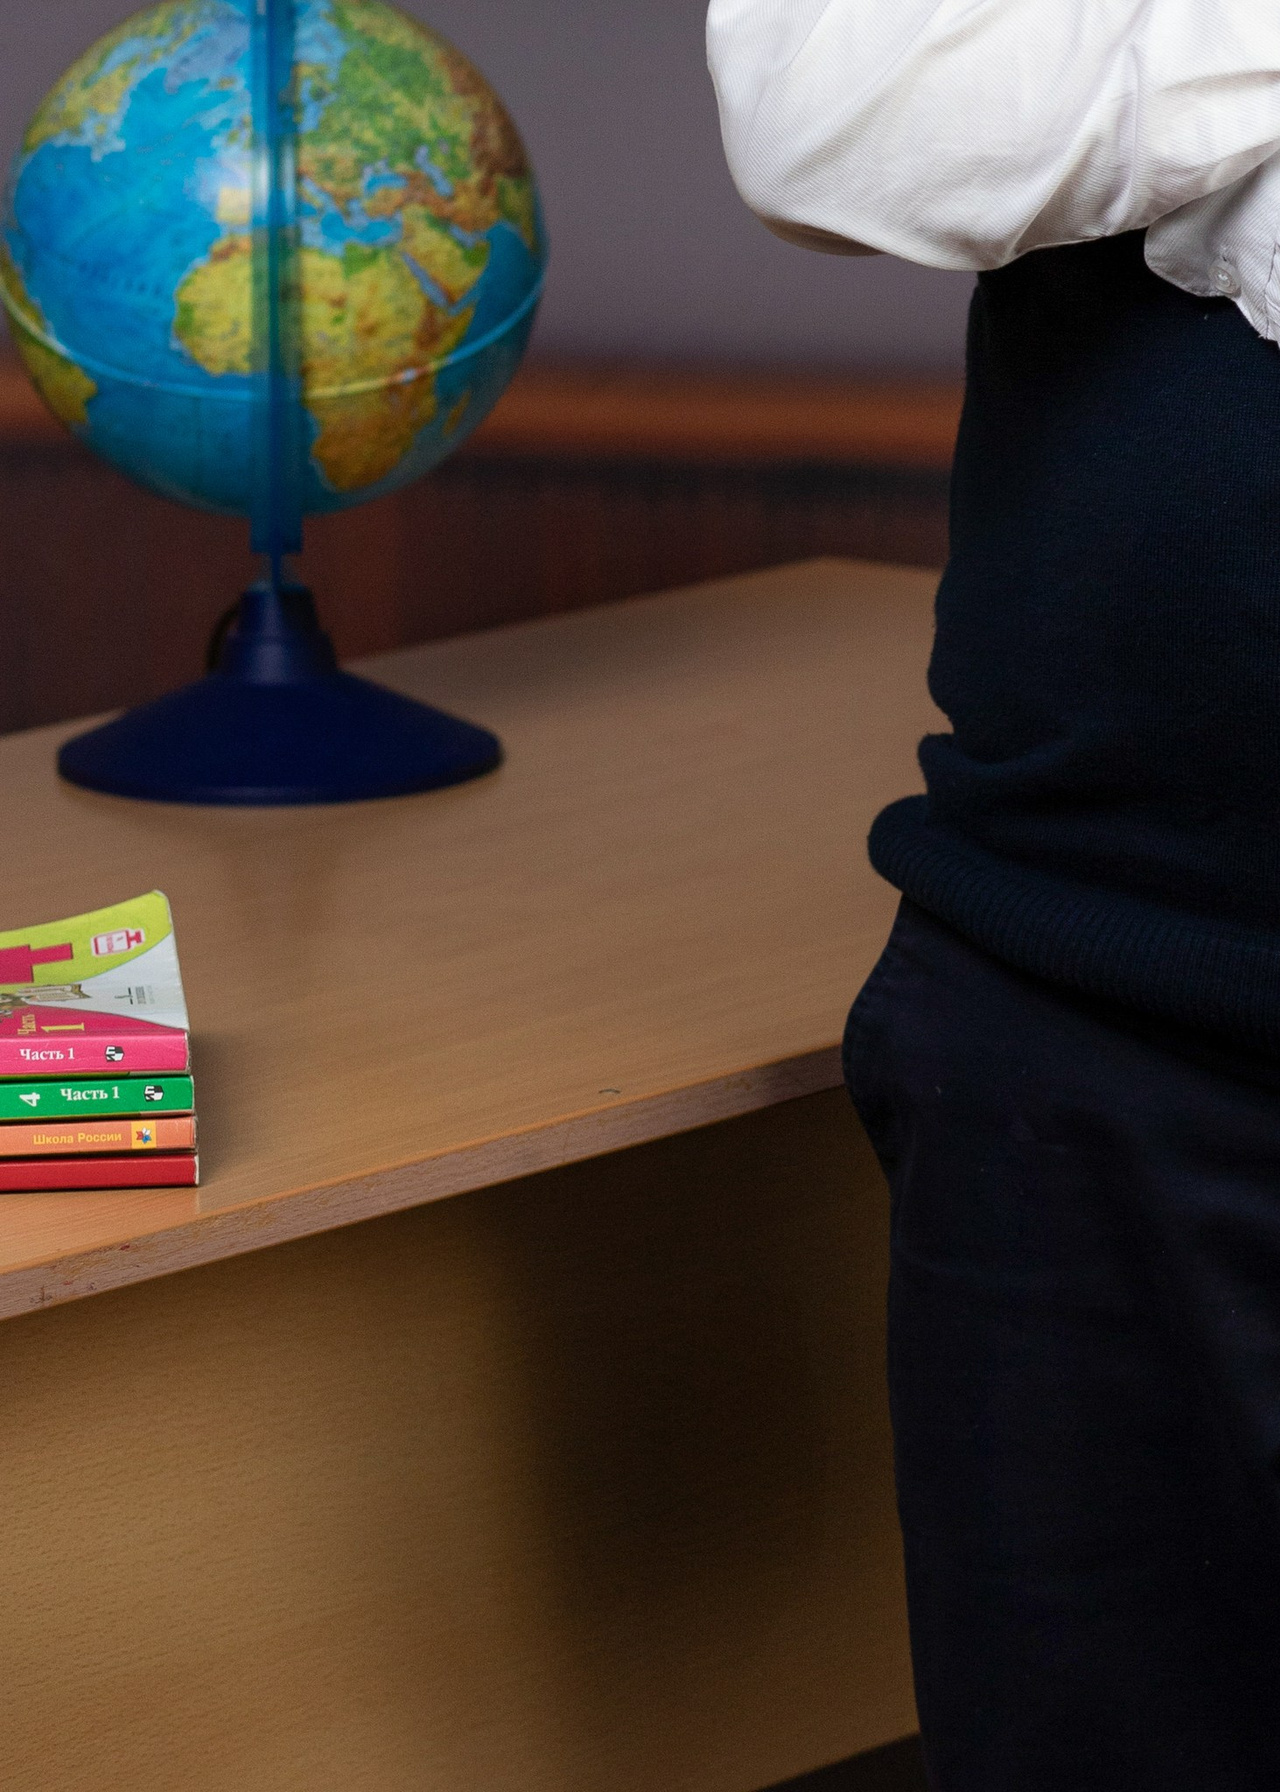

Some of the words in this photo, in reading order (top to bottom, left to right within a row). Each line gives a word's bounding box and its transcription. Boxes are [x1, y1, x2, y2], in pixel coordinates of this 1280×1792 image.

[19, 1047, 65, 1061] Часть
[67, 1047, 76, 1060] 1
[19, 1092, 41, 1107] 4
[60, 1087, 109, 1101] Часть
[111, 1086, 120, 1099] 1
[32, 1133, 75, 1145] Школа
[77, 1131, 122, 1143] России
